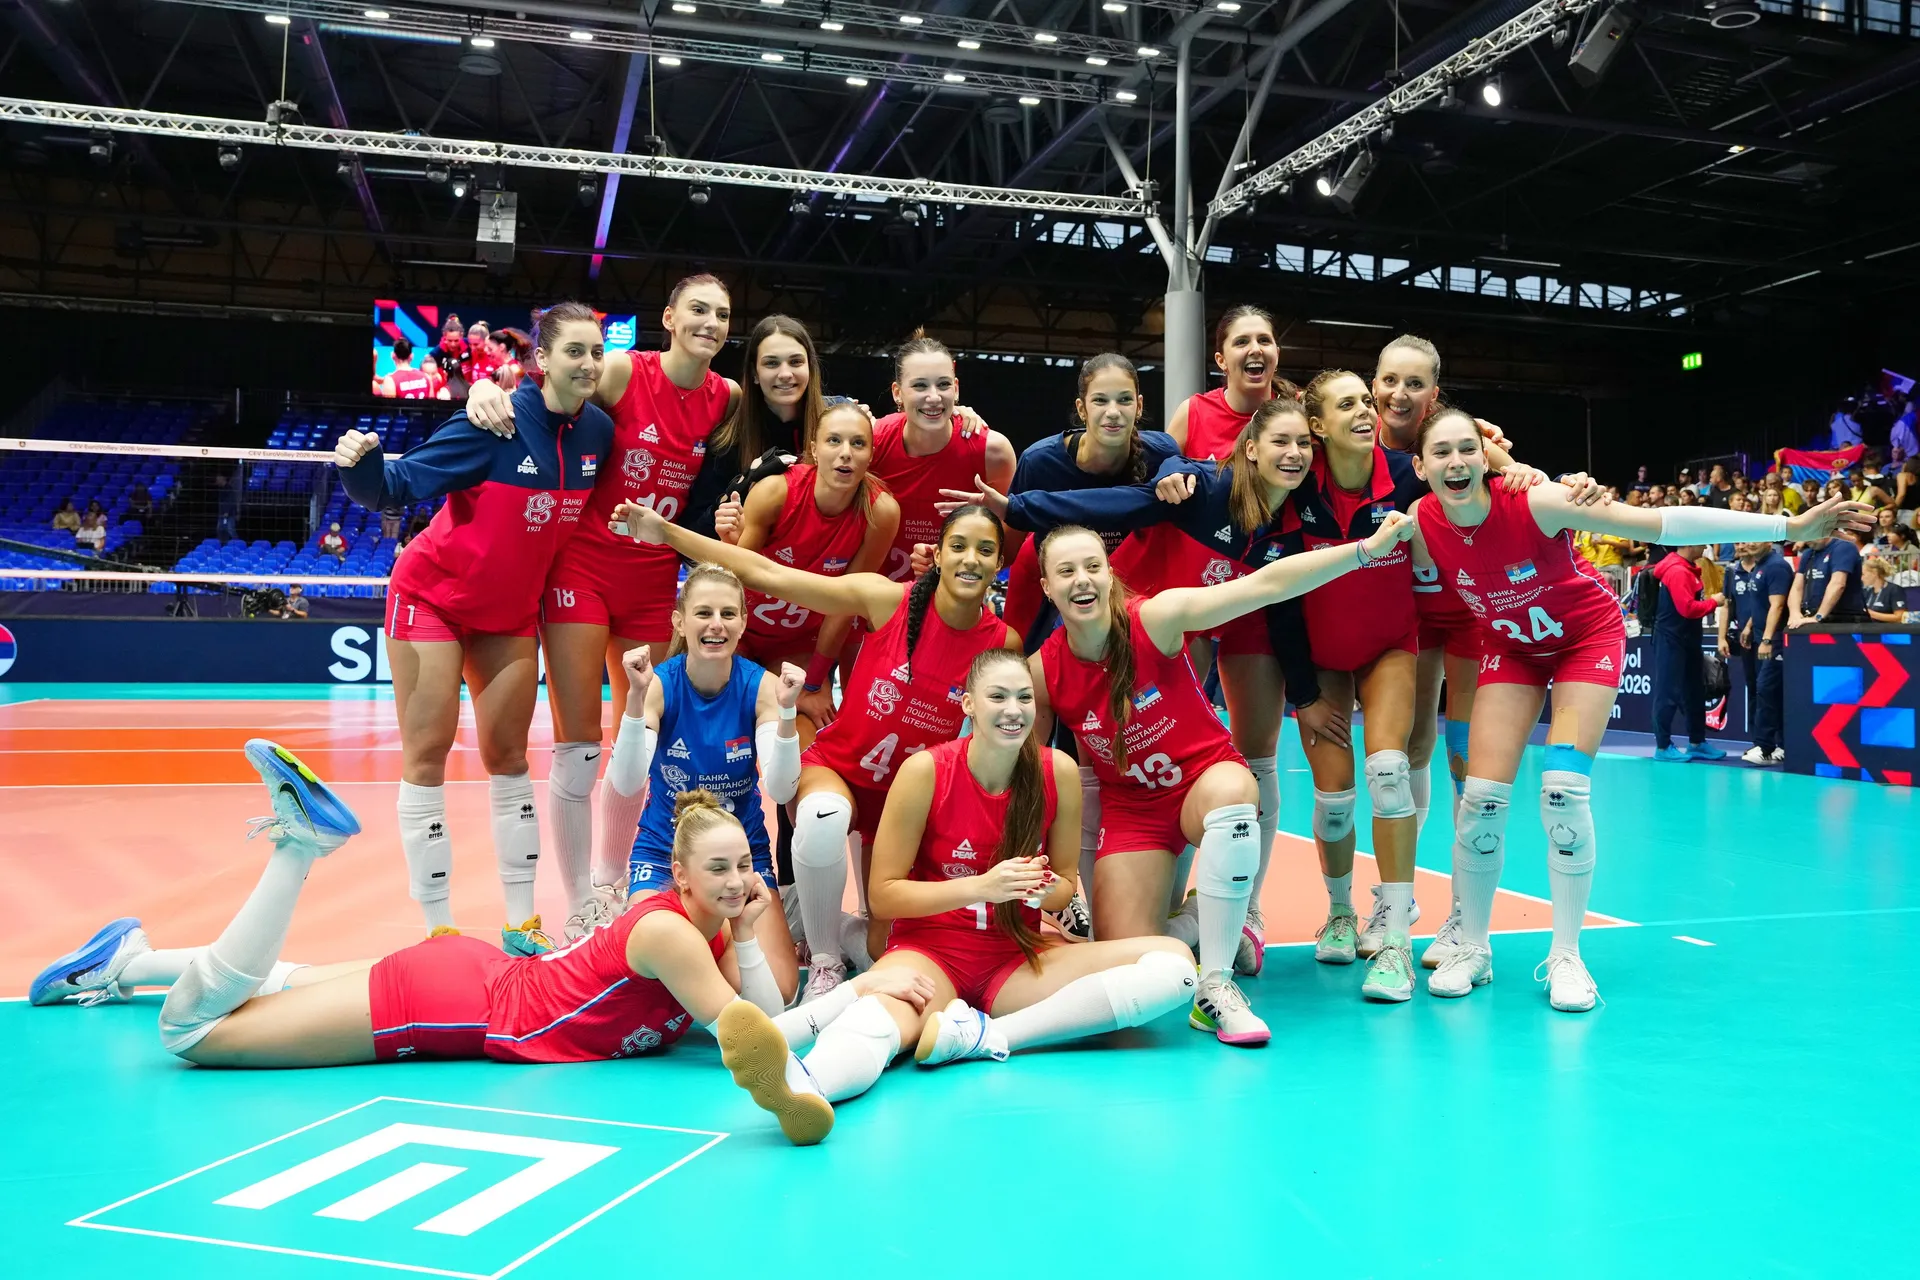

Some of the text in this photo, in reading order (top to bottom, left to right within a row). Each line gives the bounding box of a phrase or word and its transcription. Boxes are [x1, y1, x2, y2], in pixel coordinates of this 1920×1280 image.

[638, 431, 661, 445] PEAK
[517, 464, 539, 475] PEAK
[662, 459, 687, 471] БАНКА
[659, 468, 697, 481] ПОШТАНС
[624, 480, 641, 490] 1921
[657, 479, 690, 490] ШТЕДИОН
[905, 519, 933, 527] БАНКА
[905, 526, 941, 534] ПОШТАН
[905, 534, 940, 542] ШТЕДИО
[1214, 530, 1233, 544] PEAK
[1366, 554, 1408, 569] ДИОНИЦА
[553, 587, 576, 608] 18
[1486, 589, 1517, 599] БАНКА
[753, 593, 810, 628] 25
[1491, 606, 1564, 644] 34
[1480, 653, 1501, 674] 34
[909, 697, 939, 714] БАНКА
[865, 708, 883, 721] 1921
[1082, 720, 1103, 732] PEAK
[1123, 722, 1144, 737] АНКА
[1124, 715, 1169, 745] ОШТАНСКА
[666, 748, 692, 761] PEAK
[698, 773, 730, 782] БАНКА
[1125, 753, 1182, 790] 13
[951, 849, 978, 860] PEAK
[633, 863, 653, 883] 16
